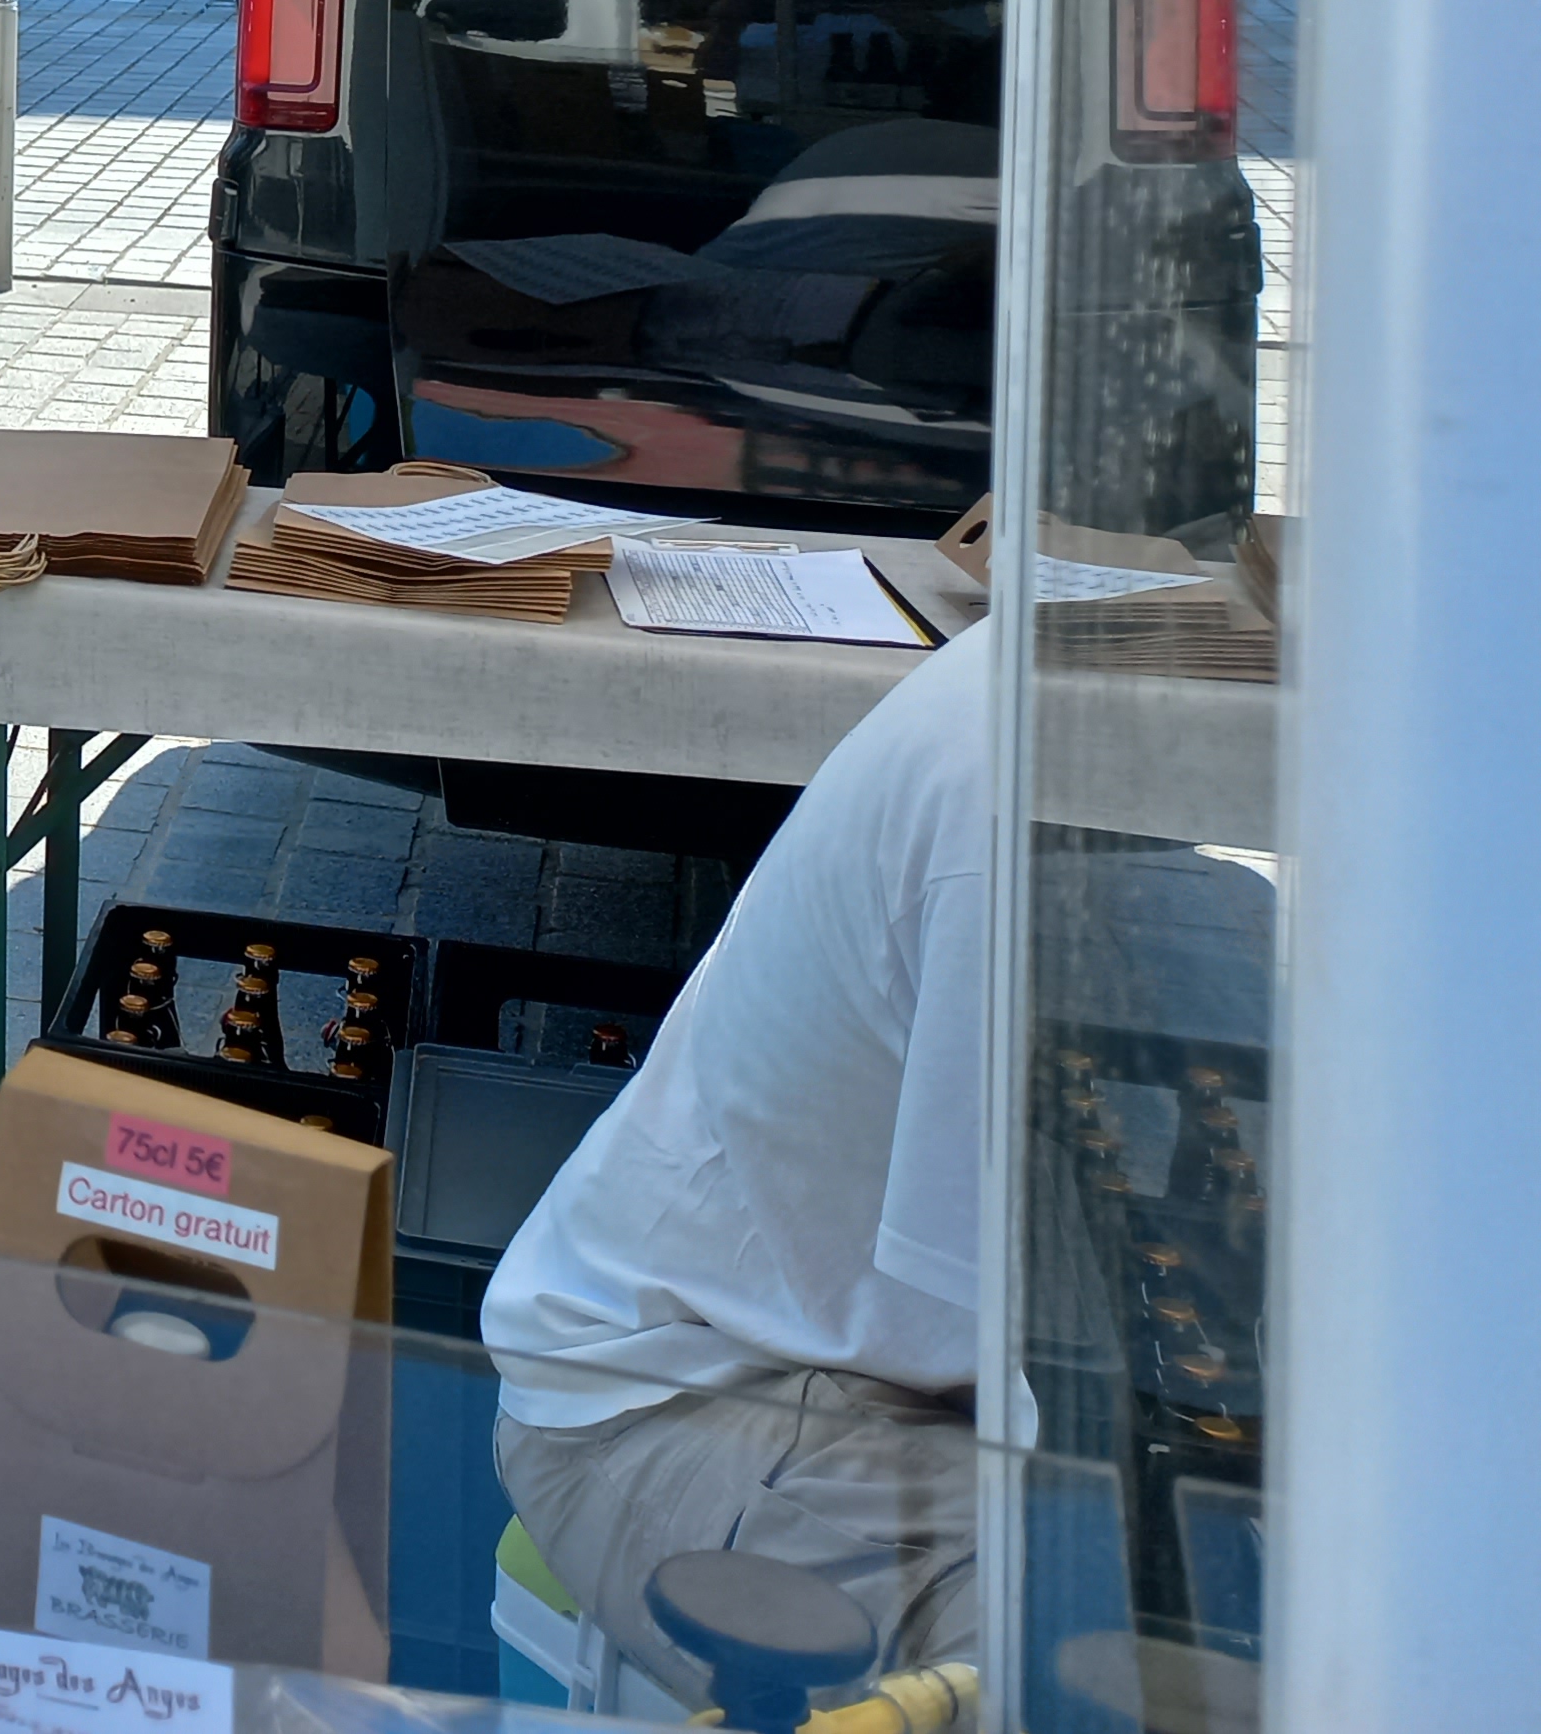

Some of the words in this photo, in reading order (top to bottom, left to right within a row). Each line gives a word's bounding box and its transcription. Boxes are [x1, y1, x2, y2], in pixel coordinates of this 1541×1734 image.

[116, 1127, 178, 1170] 75cl
[185, 1144, 226, 1182] 5€
[67, 1175, 166, 1229] Carton
[174, 1206, 272, 1255] gratuit
[107, 1668, 202, 1720] Anges
